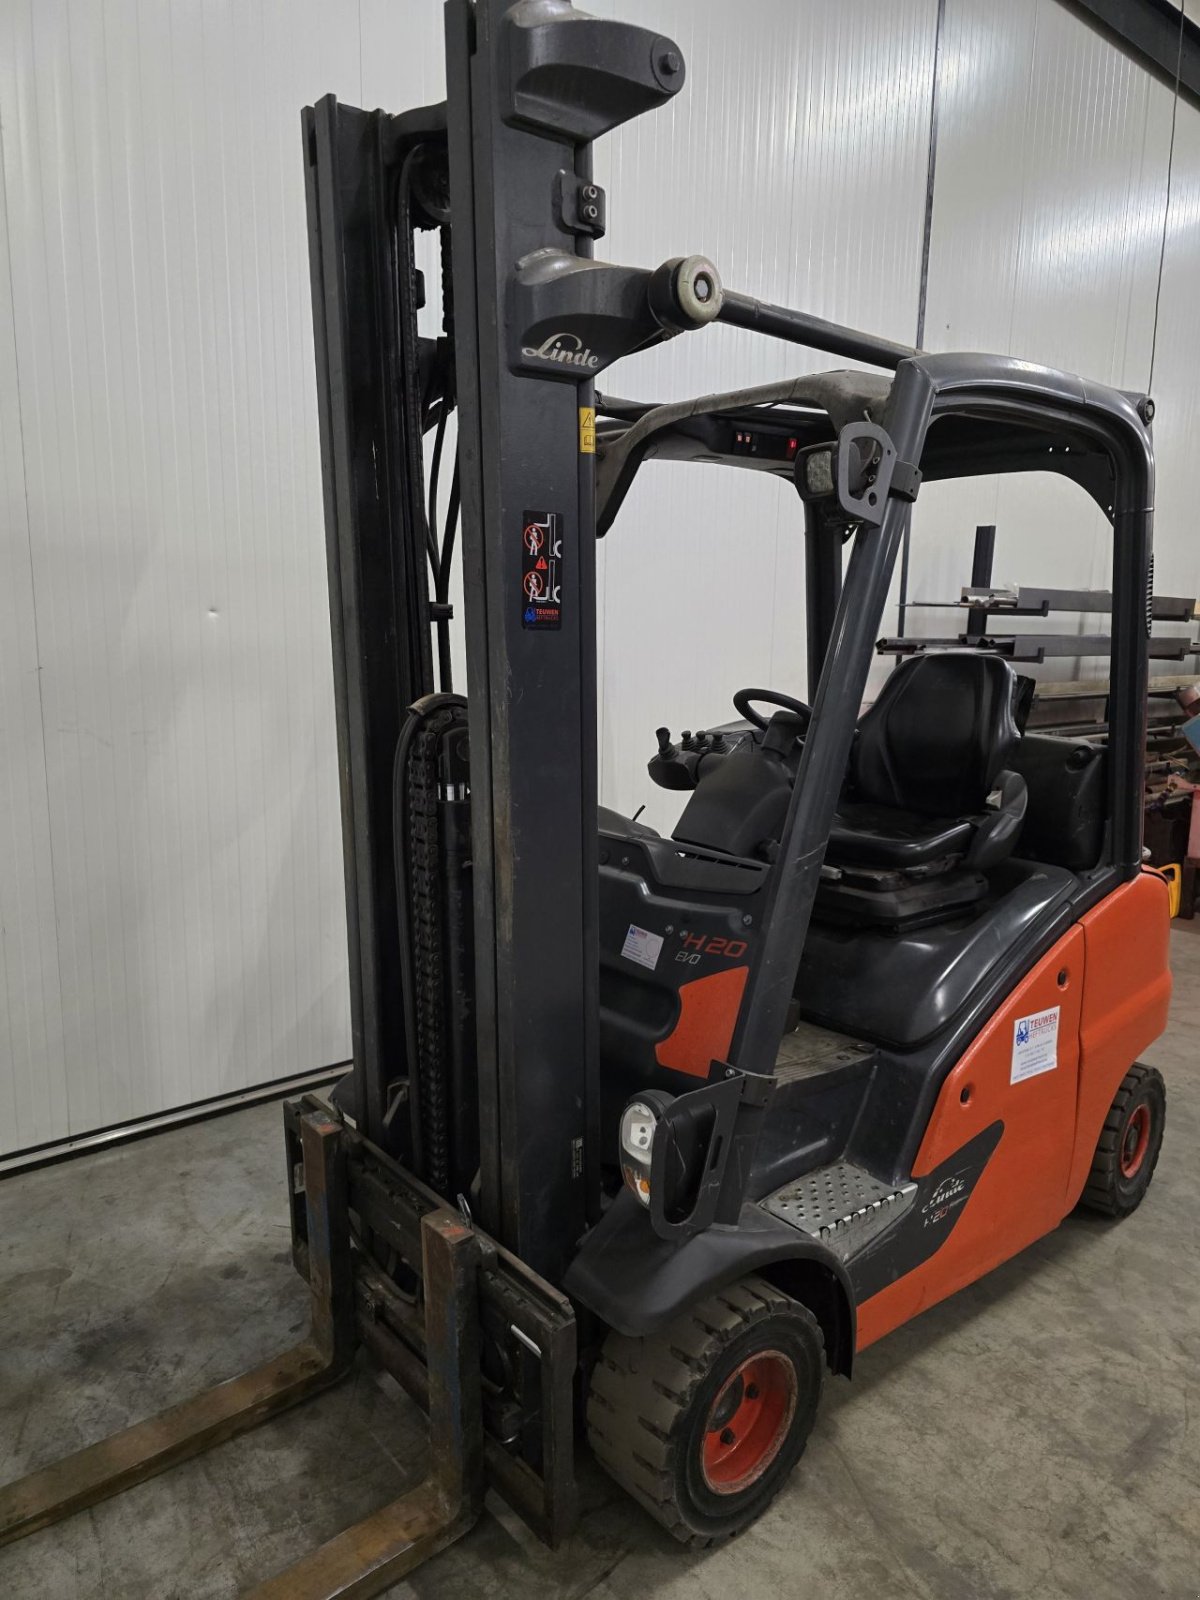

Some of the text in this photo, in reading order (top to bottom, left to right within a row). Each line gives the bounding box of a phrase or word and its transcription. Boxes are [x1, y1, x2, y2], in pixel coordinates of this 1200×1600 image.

[522, 332, 599, 368] Linde
[675, 951, 702, 965] EVO
[1030, 1013, 1057, 1028] TEUWEN
